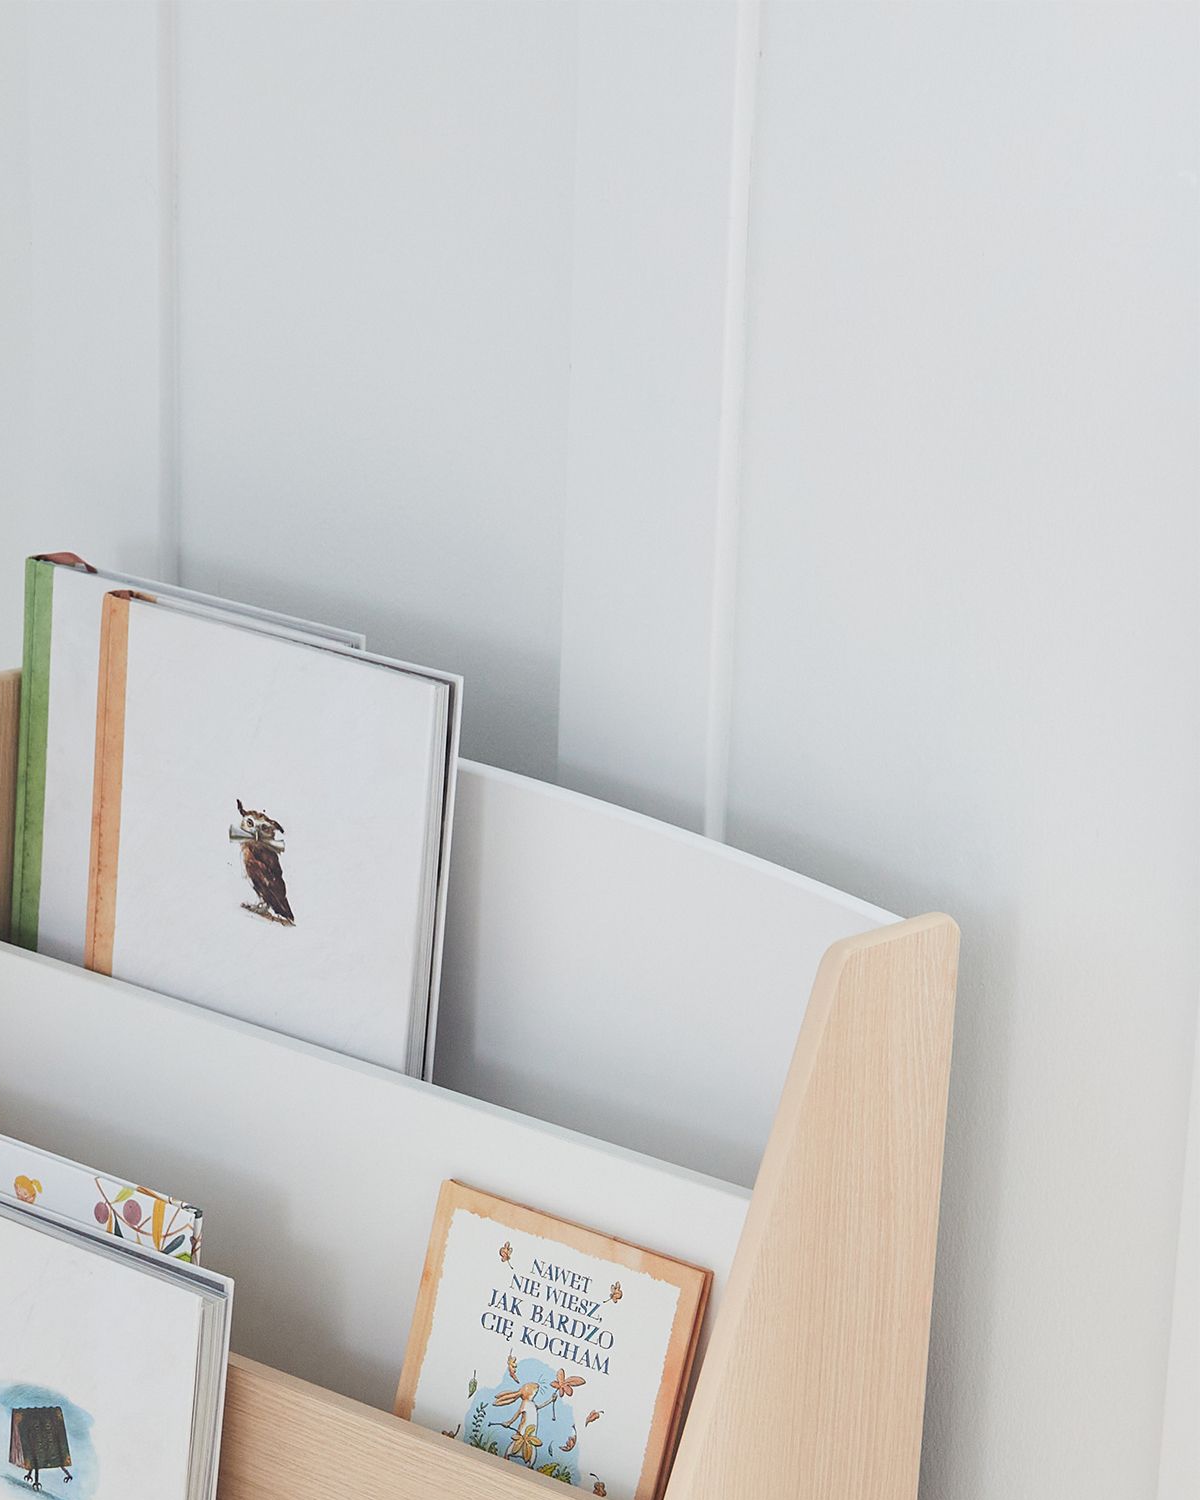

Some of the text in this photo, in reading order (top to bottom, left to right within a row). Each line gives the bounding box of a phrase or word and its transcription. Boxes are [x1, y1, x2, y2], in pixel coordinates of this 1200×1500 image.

[509, 1273, 602, 1323] NIE WIESZ,
[530, 1258, 592, 1294] NAWET
[481, 1311, 610, 1375] CIĘ KOCHAM
[488, 1288, 614, 1350] JAK BARDZO
